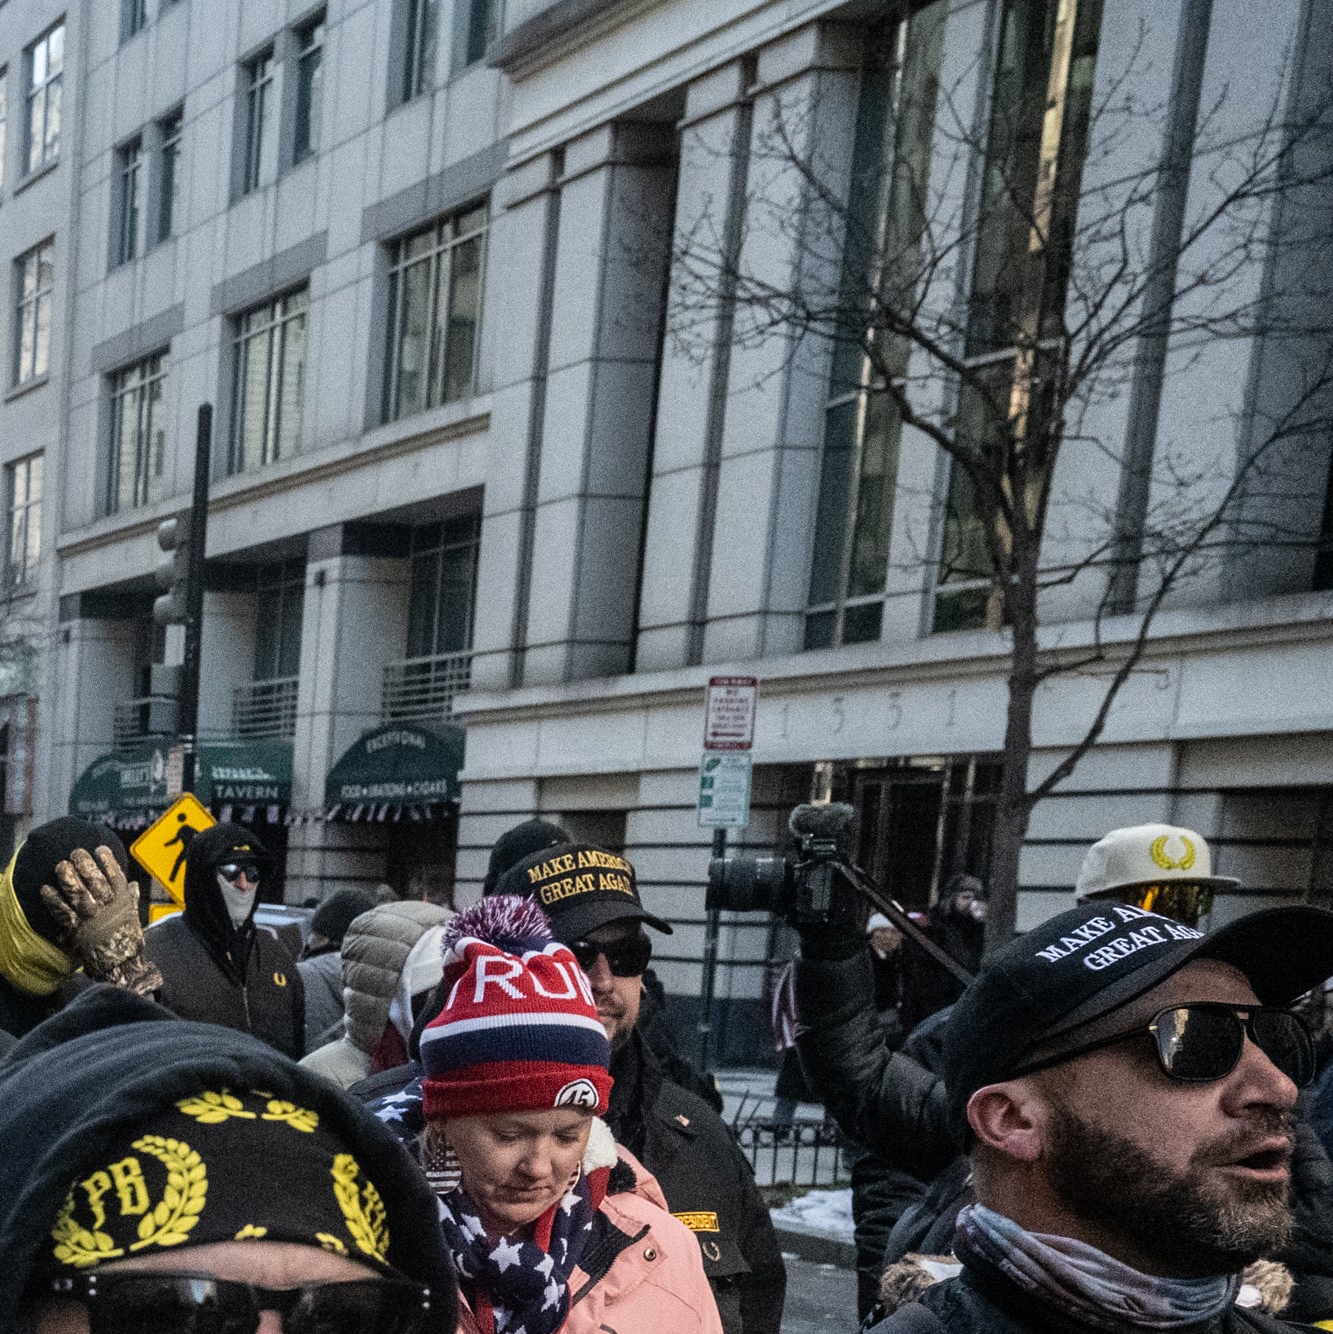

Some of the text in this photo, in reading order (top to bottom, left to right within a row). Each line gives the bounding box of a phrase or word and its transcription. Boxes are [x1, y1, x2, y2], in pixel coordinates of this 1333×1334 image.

[215, 784, 279, 799] TAVERN
[527, 852, 577, 884] MAKE
[540, 873, 596, 905] GREAT
[1035, 916, 1117, 963] MAKE
[1083, 925, 1169, 971] GREAT
